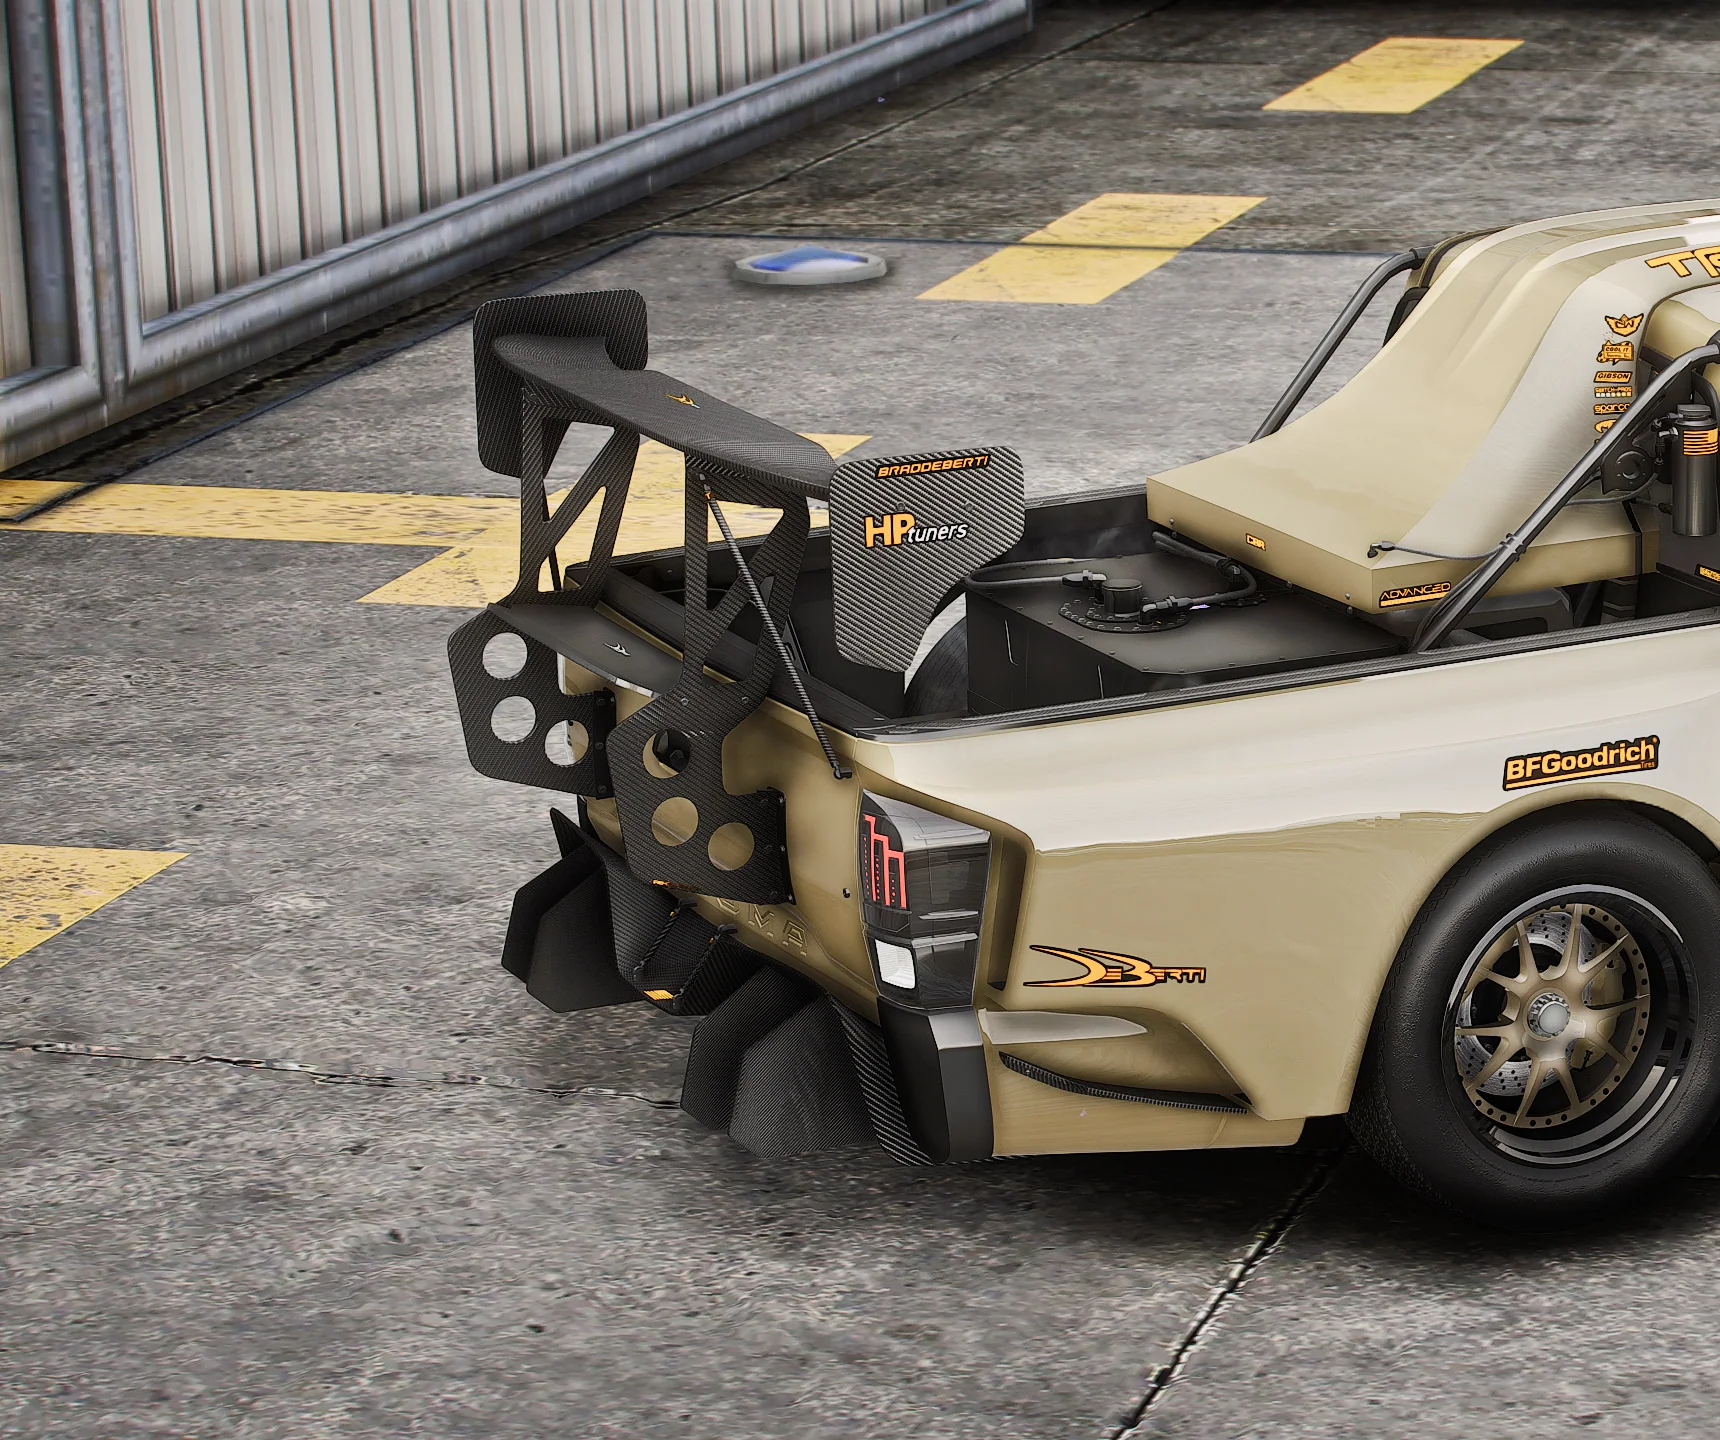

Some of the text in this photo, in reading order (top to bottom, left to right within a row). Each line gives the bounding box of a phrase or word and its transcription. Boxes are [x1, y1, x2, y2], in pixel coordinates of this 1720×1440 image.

[877, 455, 989, 478] BRADDEBERTI
[1380, 582, 1451, 600] ADVANCED
[1506, 739, 1656, 781] BFGoodrich
